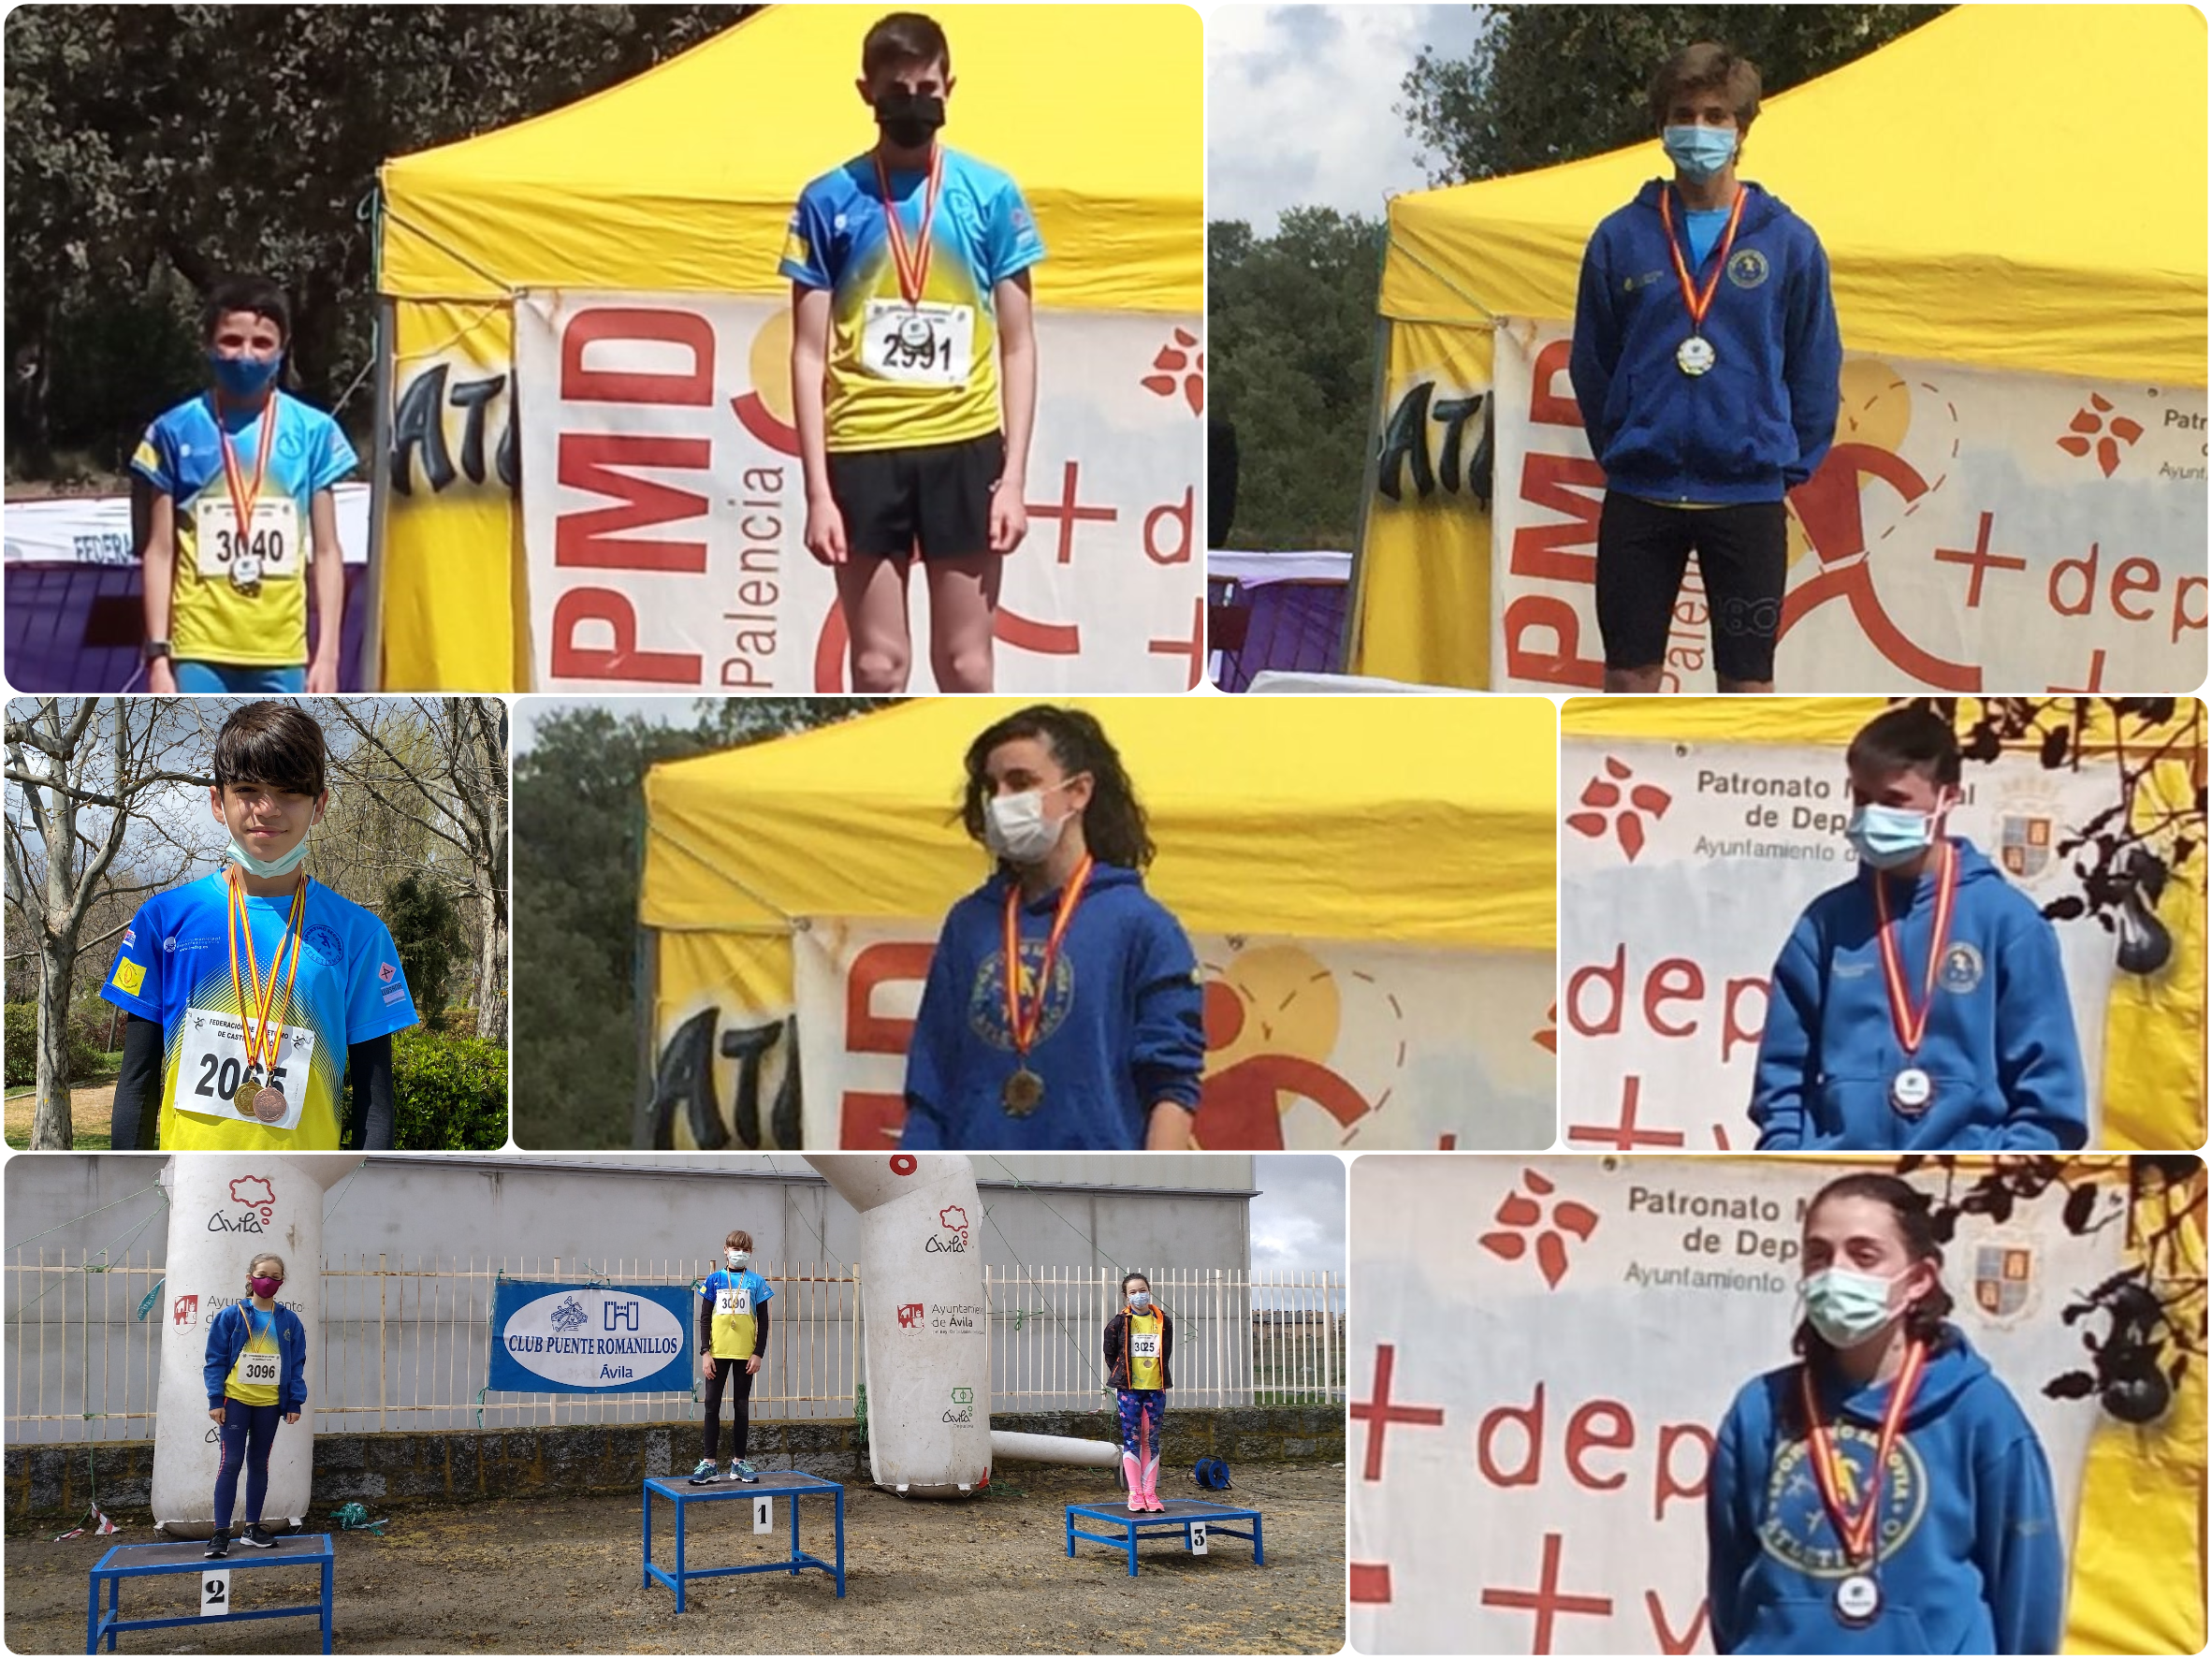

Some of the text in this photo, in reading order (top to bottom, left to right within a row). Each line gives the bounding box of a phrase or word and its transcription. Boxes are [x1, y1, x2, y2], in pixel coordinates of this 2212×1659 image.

[551, 308, 716, 685] PMD
[721, 466, 784, 689] Palencia
[1696, 770, 1831, 798] Patronato
[1745, 805, 1780, 828] de
[1694, 836, 1835, 863] Ayuntamiento
[1628, 1186, 1781, 1222] Patronato
[207, 1210, 264, 1233] Ávila
[1682, 1227, 1721, 1254] de
[1624, 1261, 1785, 1293] Ayuntamiento
[950, 1314, 973, 1327] Ávila
[508, 1334, 677, 1355] CLUB PUENTE ROMANILLOS
[1134, 1342, 1155, 1352] 3025
[246, 1364, 275, 1378] 3096
[600, 1364, 633, 1379] Ávila
[757, 1504, 767, 1524] 1
[1194, 1529, 1205, 1547] 3
[205, 1579, 226, 1604] 2
